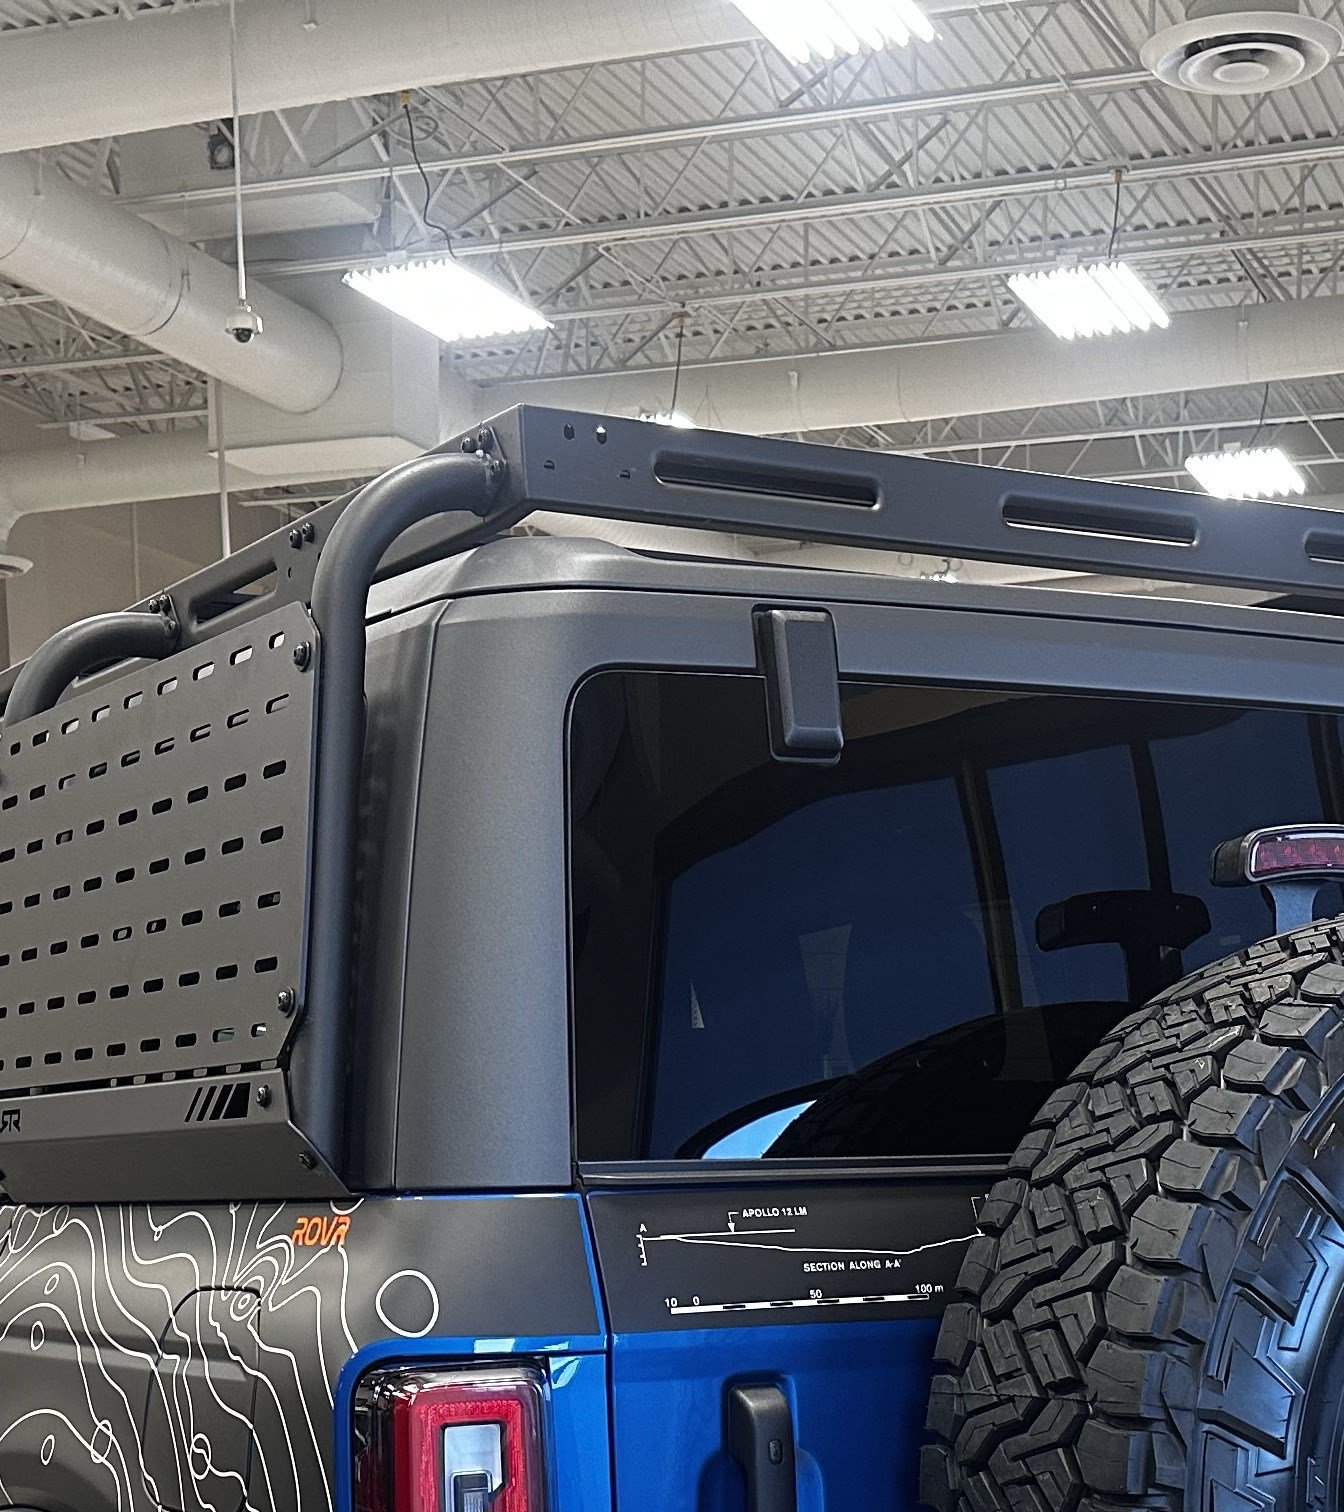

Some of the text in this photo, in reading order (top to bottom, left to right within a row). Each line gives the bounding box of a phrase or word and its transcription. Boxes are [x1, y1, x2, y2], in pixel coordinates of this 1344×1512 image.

[742, 1206, 808, 1218] APOLLO 12 LM
[292, 1216, 351, 1246] ROVR
[639, 1223, 648, 1233] A
[803, 1261, 845, 1272] SECTION
[849, 1259, 882, 1270] ALONG
[664, 1284, 944, 1308] 10 0 50 100 m
